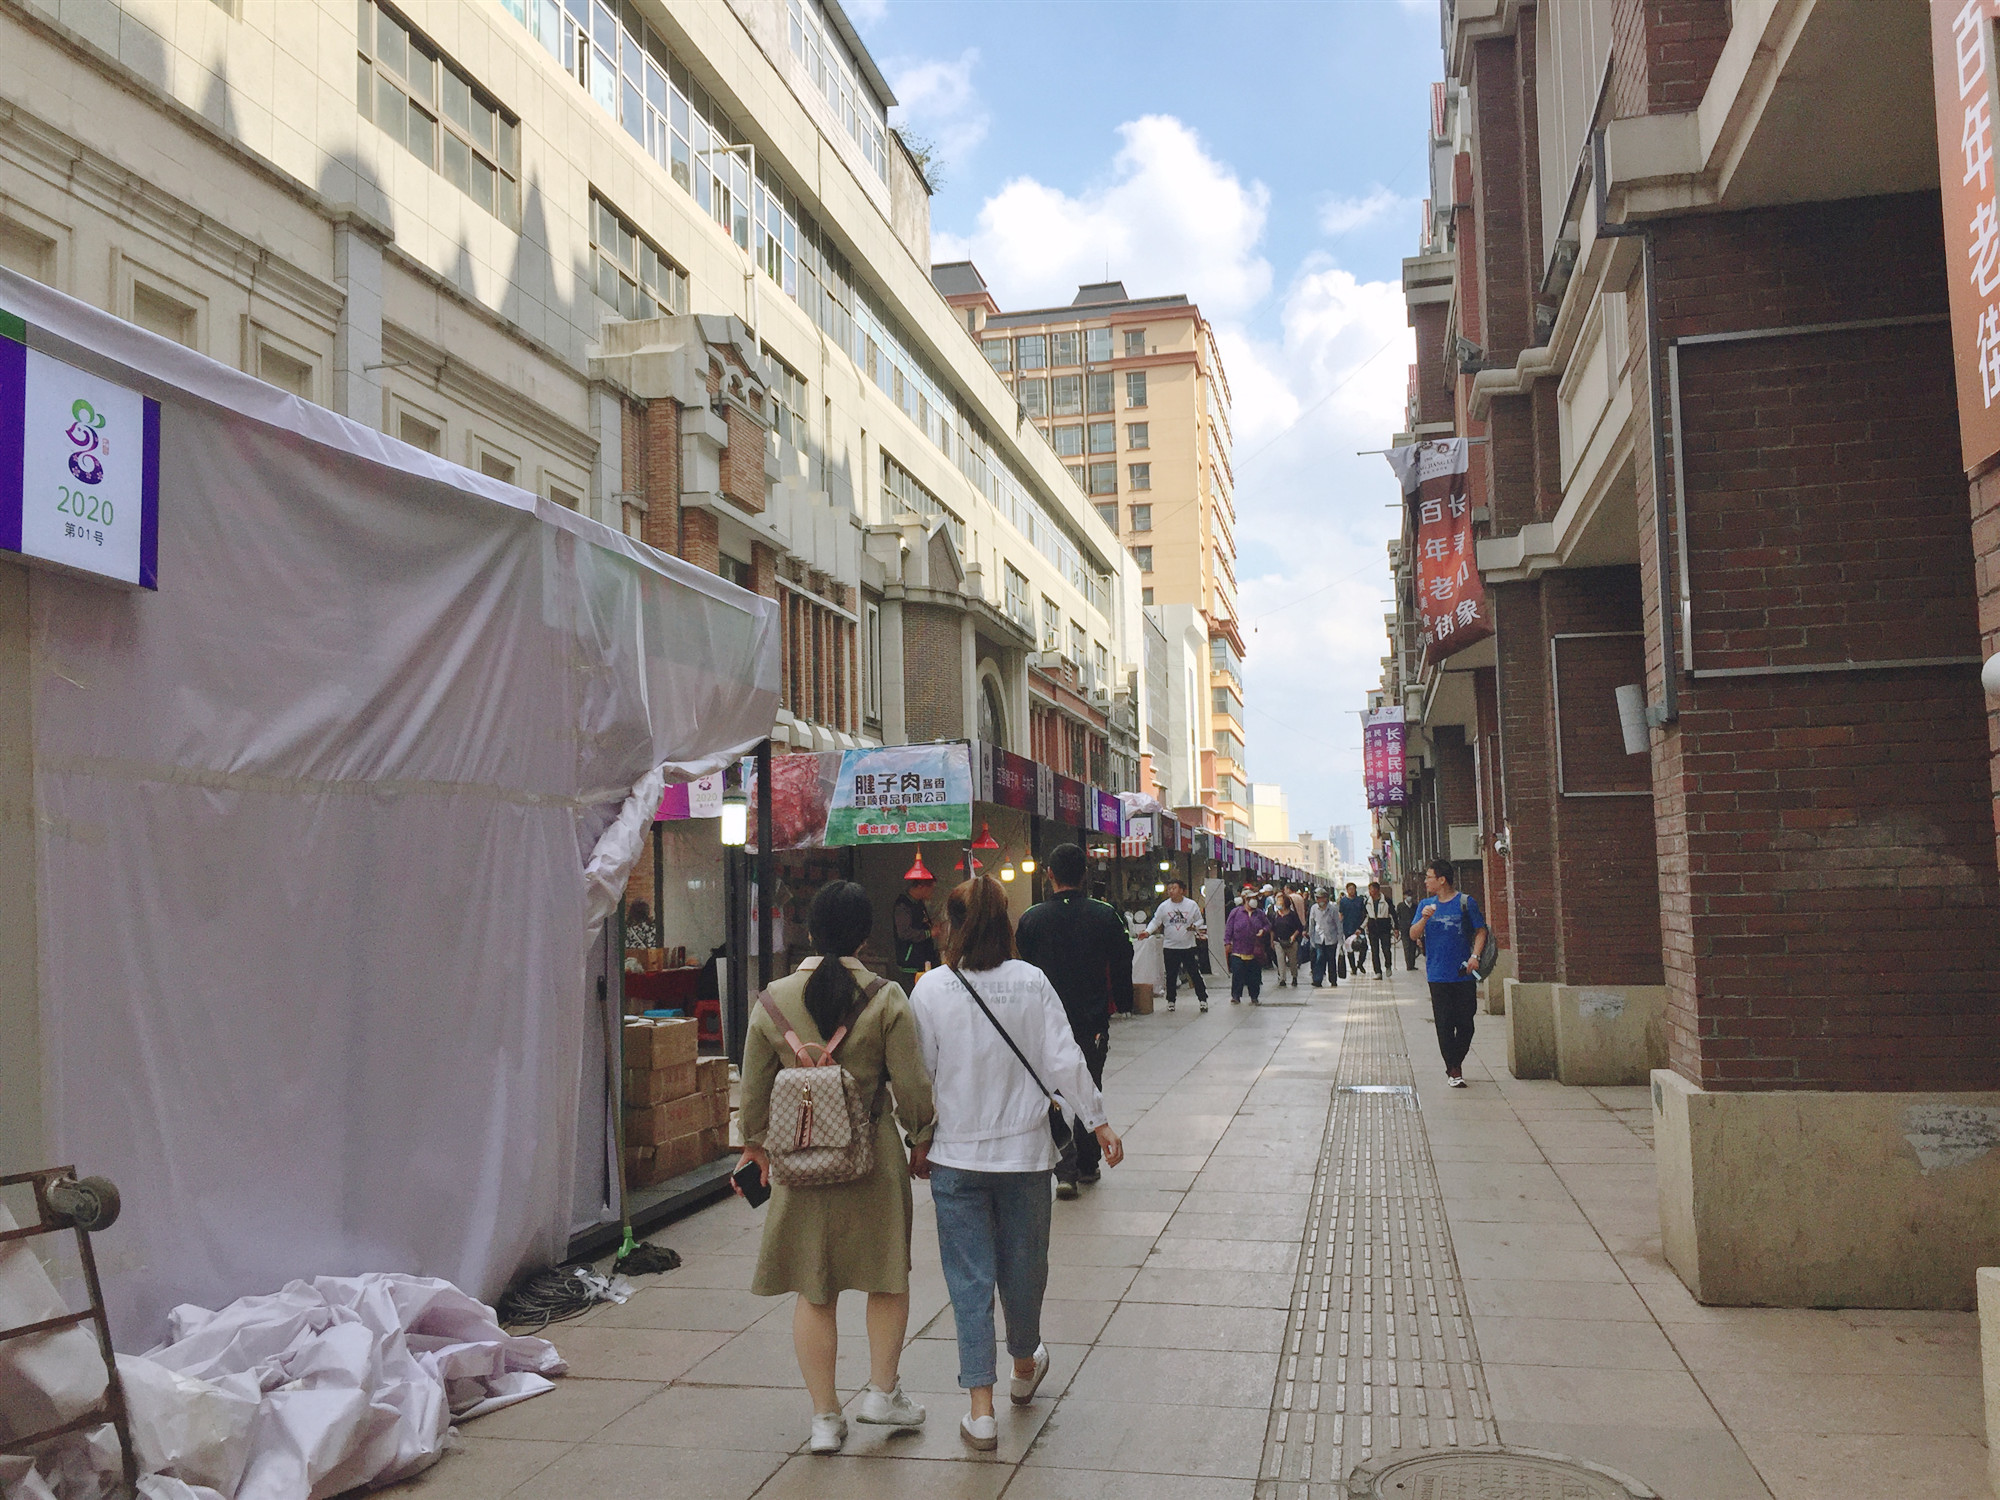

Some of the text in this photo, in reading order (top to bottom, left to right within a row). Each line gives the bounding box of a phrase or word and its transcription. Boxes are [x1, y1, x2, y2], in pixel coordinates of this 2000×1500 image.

[57, 486, 114, 526] 2020
[64, 521, 104, 547] 第01号
[1419, 498, 1455, 640] 百年老街
[1386, 727, 1404, 801] 长春民博会
[696, 792, 718, 802] 2020
[855, 772, 921, 794] 腱子肉
